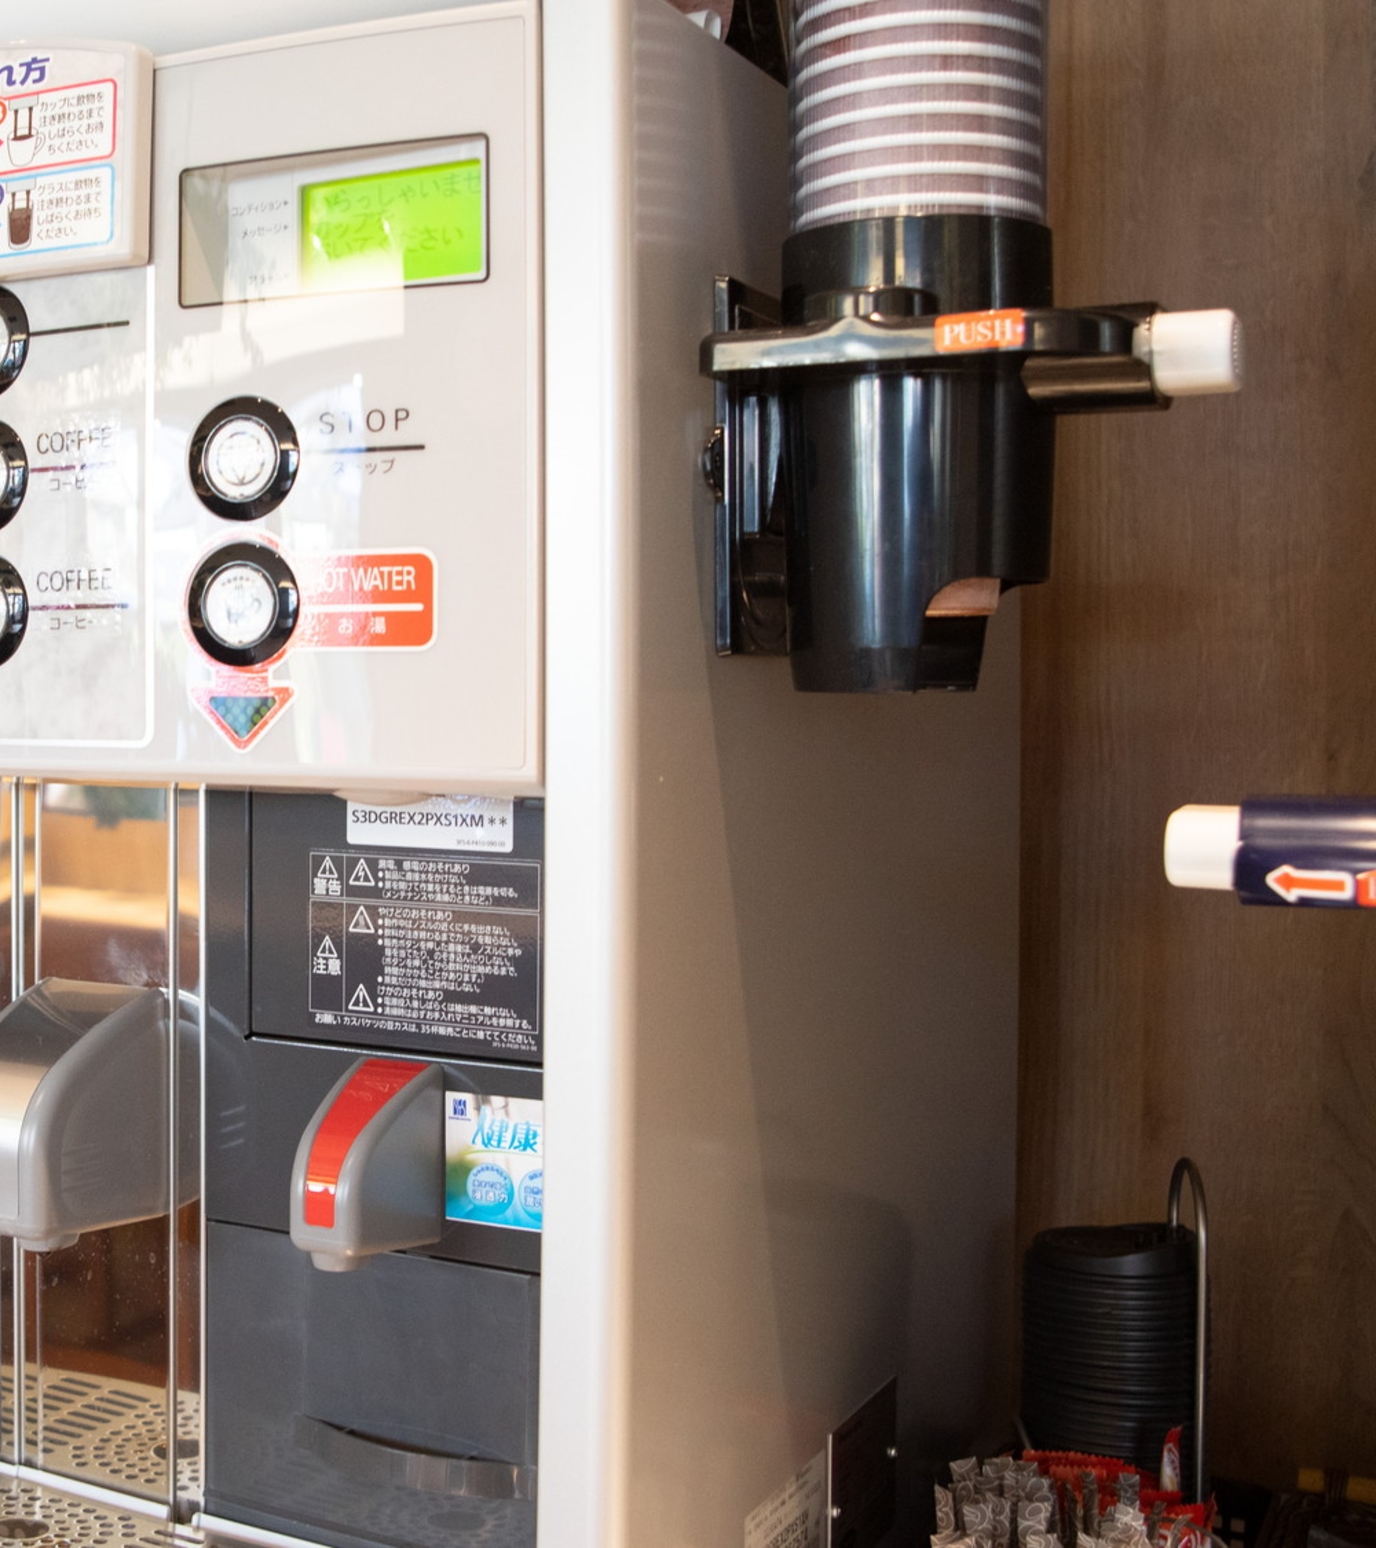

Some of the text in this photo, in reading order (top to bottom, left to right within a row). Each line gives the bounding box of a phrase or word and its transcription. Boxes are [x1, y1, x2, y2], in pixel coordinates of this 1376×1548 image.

[40, 93, 104, 112] カップに飲物を
[39, 108, 104, 128] 注ぎ終わるまで
[47, 122, 104, 141] しばらくお待
[48, 138, 99, 155] ちください。
[37, 176, 102, 196] グラスに飲物を
[37, 192, 101, 211] 注ぎ終わるまで
[37, 207, 101, 226] しばらくお待ち
[36, 226, 77, 241] ください。
[943, 318, 1014, 346] PUSH
[332, 457, 395, 475] スップ
[319, 565, 417, 592] OT WATER
[314, 877, 341, 895] 警告
[378, 907, 453, 921] やけどのおそれあり
[313, 957, 341, 975] 注意
[377, 985, 444, 1000] けがのおそれあり
[471, 1105, 541, 1153] 健康
